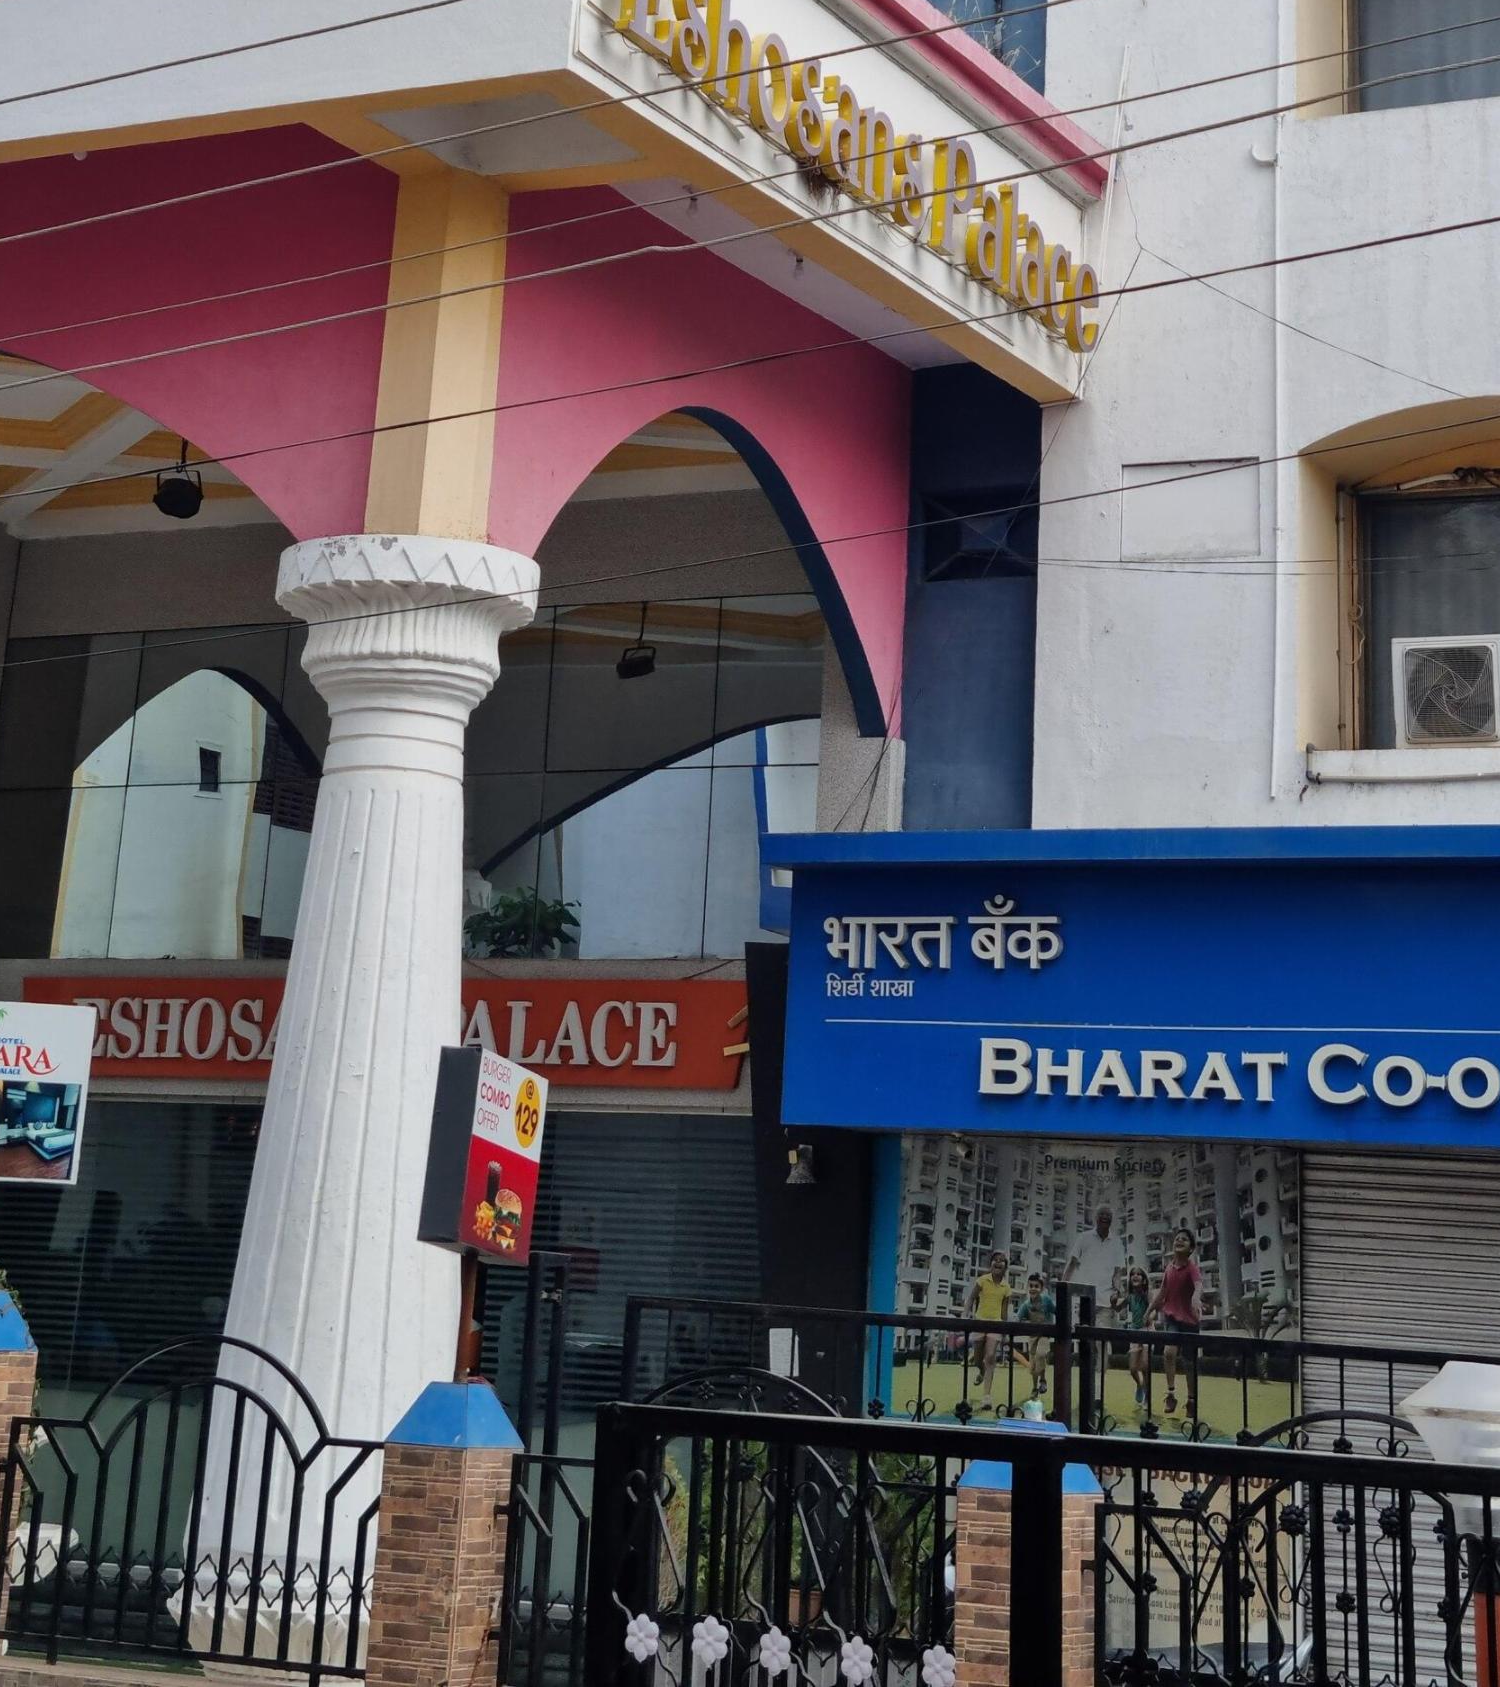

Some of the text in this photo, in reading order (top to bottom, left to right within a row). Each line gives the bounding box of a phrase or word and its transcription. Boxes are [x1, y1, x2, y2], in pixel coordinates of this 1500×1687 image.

[927, 137, 1101, 354] Palace
[823, 894, 1063, 970] भारत बँक
[826, 973, 916, 998] शिर्डी शाखा
[461, 998, 678, 1067] ALACE
[483, 1055, 512, 1086] BURGER
[978, 1037, 1289, 1103] BHARAT
[480, 1081, 512, 1111] COMBO
[476, 1107, 501, 1133] OFFER
[515, 1101, 539, 1138] 129
[1044, 1154, 1110, 1172] Premium
